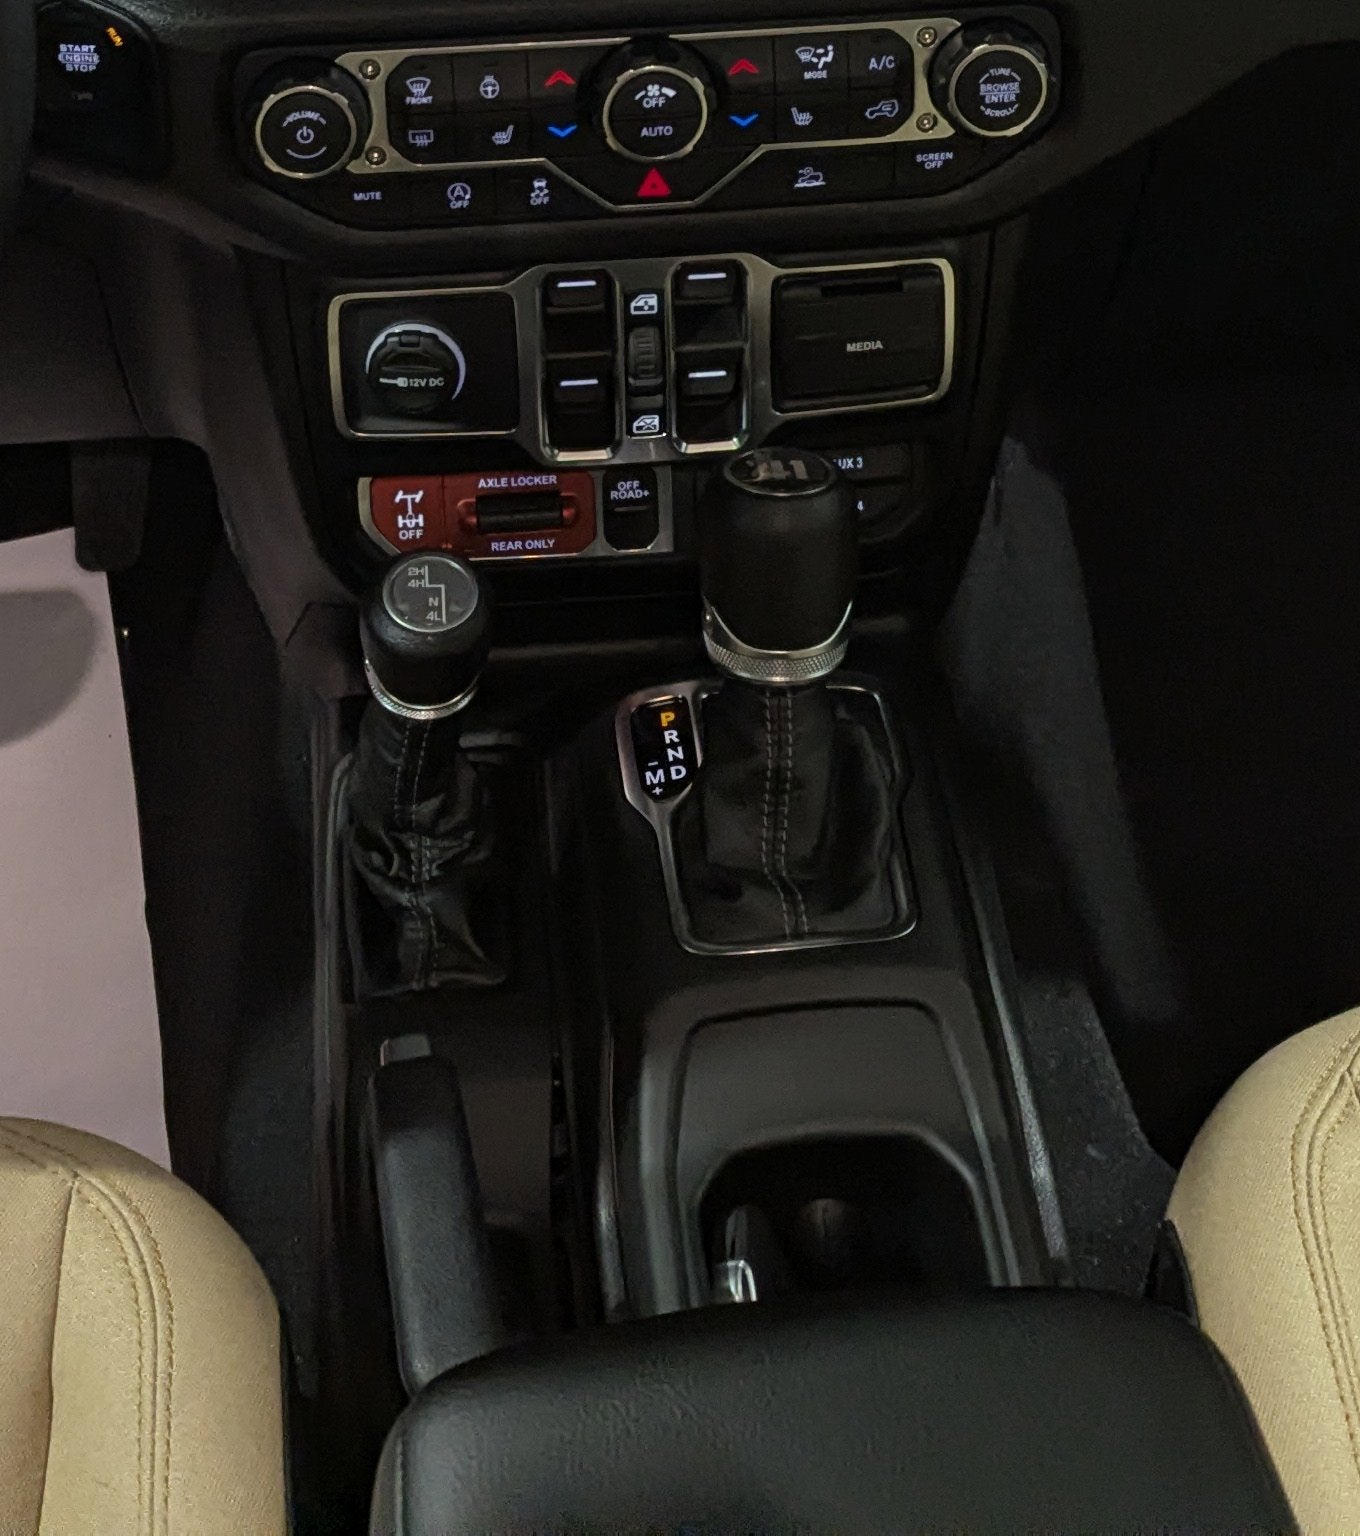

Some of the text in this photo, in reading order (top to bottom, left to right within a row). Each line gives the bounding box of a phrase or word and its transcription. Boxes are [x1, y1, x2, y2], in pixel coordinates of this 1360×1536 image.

[60, 44, 96, 52] START
[60, 54, 99, 64] ENGINE
[869, 54, 895, 71] A/C
[65, 64, 96, 72] STOP
[989, 67, 1011, 77] TUNE
[804, 70, 828, 80] MODE
[980, 81, 1020, 93] BROWSE
[405, 95, 433, 106] FRONT
[642, 96, 667, 109] OFF
[985, 93, 1017, 104] ENTER
[641, 125, 674, 137] AUTO
[916, 151, 953, 164] SCREEN
[924, 160, 943, 170] OFF
[353, 191, 382, 202] MUTE
[529, 195, 550, 206] OFF
[449, 200, 470, 210] OFF
[846, 338, 884, 353] MEDIA
[409, 377, 445, 387] 12V DC
[833, 457, 863, 470] UX 3
[478, 475, 557, 489] AXLE LOCKER
[617, 480, 640, 491] OFF
[610, 489, 649, 500] ROAD+
[856, 500, 864, 512] 4
[398, 529, 424, 540] OFF
[491, 538, 556, 552] REAR ONLY
[408, 567, 424, 576] 2H
[408, 579, 426, 588] 4H
[428, 597, 439, 607] N
[425, 611, 441, 621] 4L
[660, 711, 676, 727] P
[664, 729, 680, 744] R
[667, 745, 684, 762] N
[645, 765, 687, 786] M D
